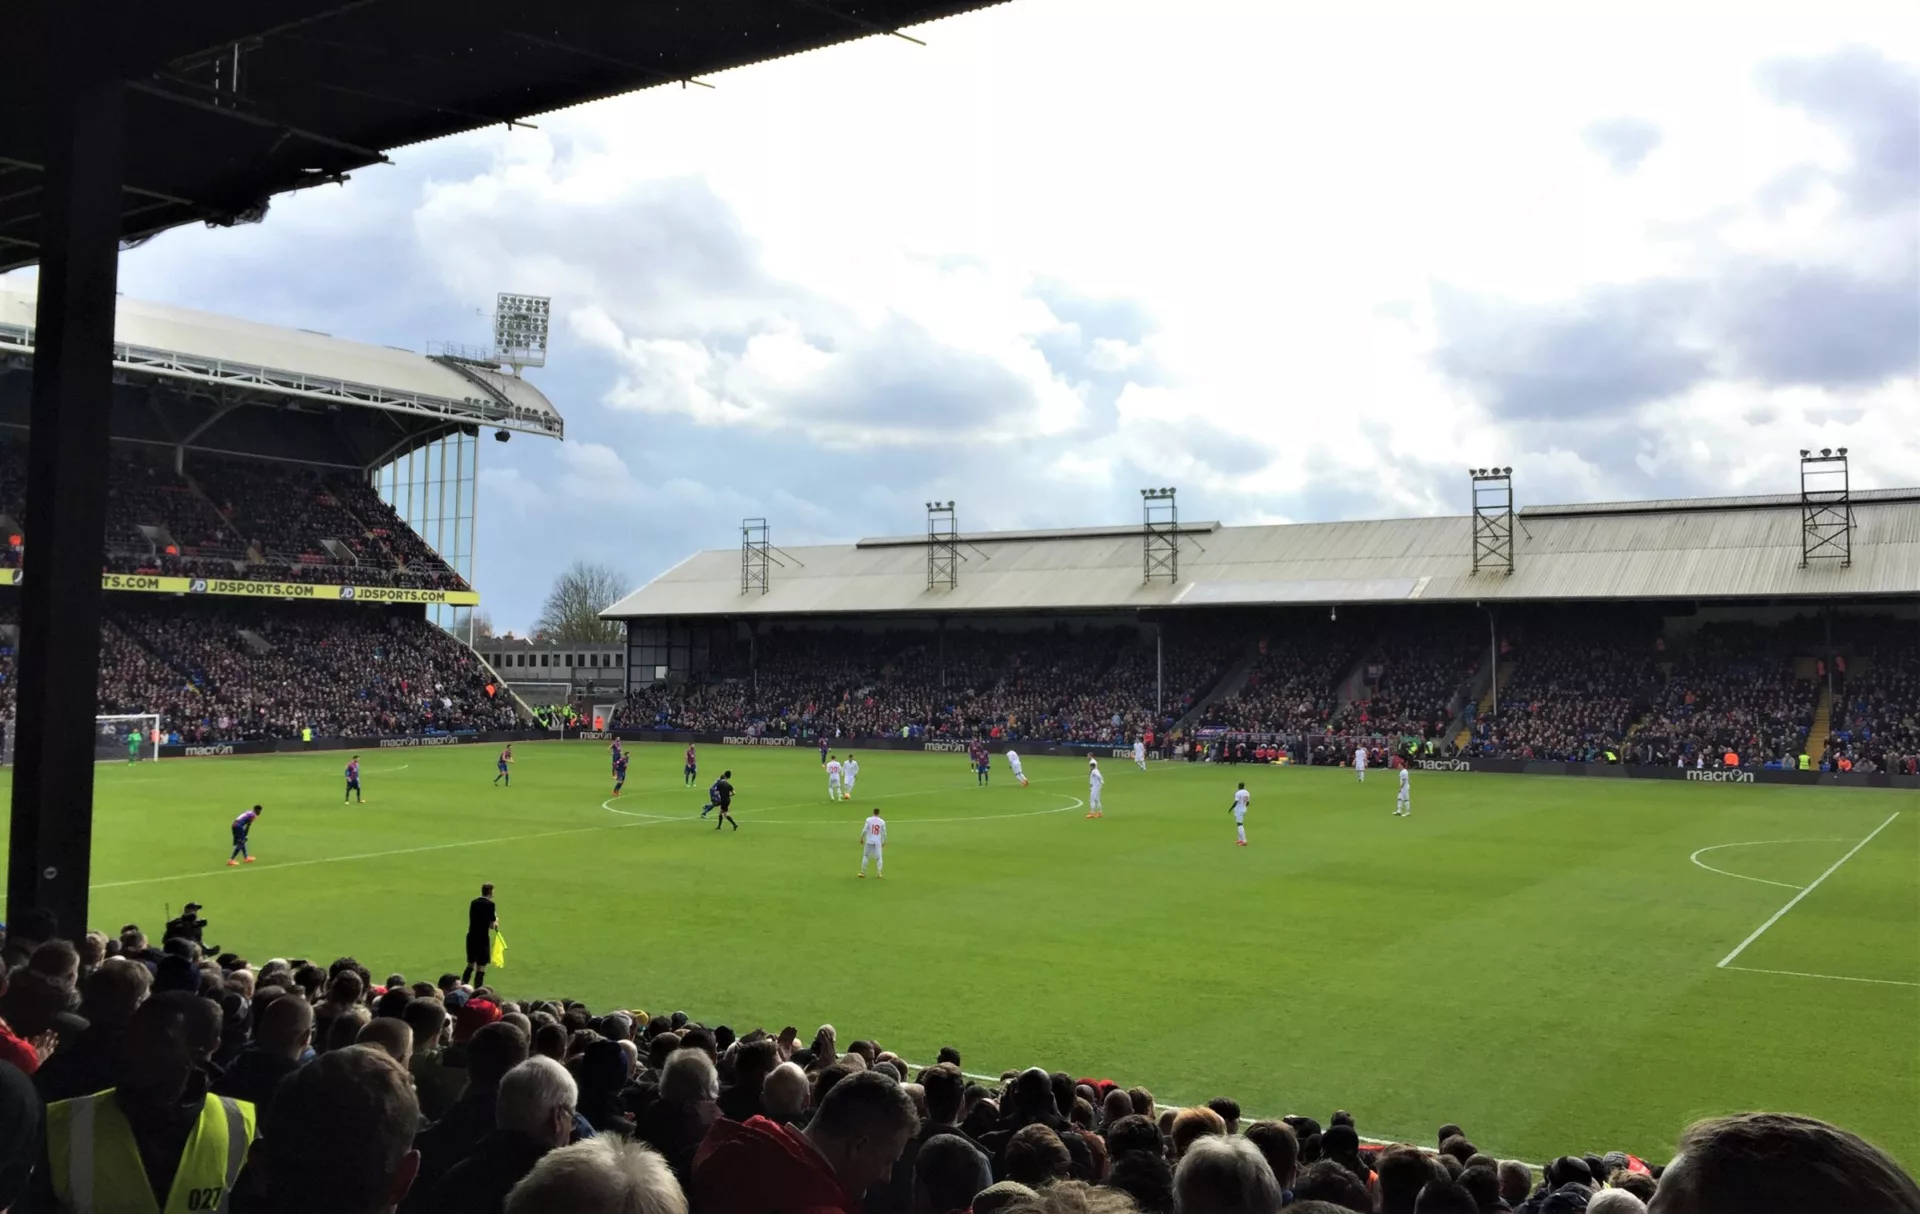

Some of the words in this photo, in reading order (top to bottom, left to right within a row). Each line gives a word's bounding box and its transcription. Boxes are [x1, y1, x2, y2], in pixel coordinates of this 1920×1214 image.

[103, 575, 159, 589] TS.COM
[211, 581, 314, 596] JDSPORTS.COM
[357, 588, 445, 601] JDSPORTS.COM
[380, 736, 419, 748] macron
[421, 734, 459, 746] macron
[580, 731, 613, 740] macron
[723, 735, 758, 745] macron
[760, 736, 796, 746] macron
[185, 744, 233, 756] macron
[924, 741, 965, 752] macron
[1112, 748, 1159, 760] macn
[1686, 769, 1754, 783] macron
[871, 824, 880, 836] 18
[188, 1186, 222, 1212] 027
